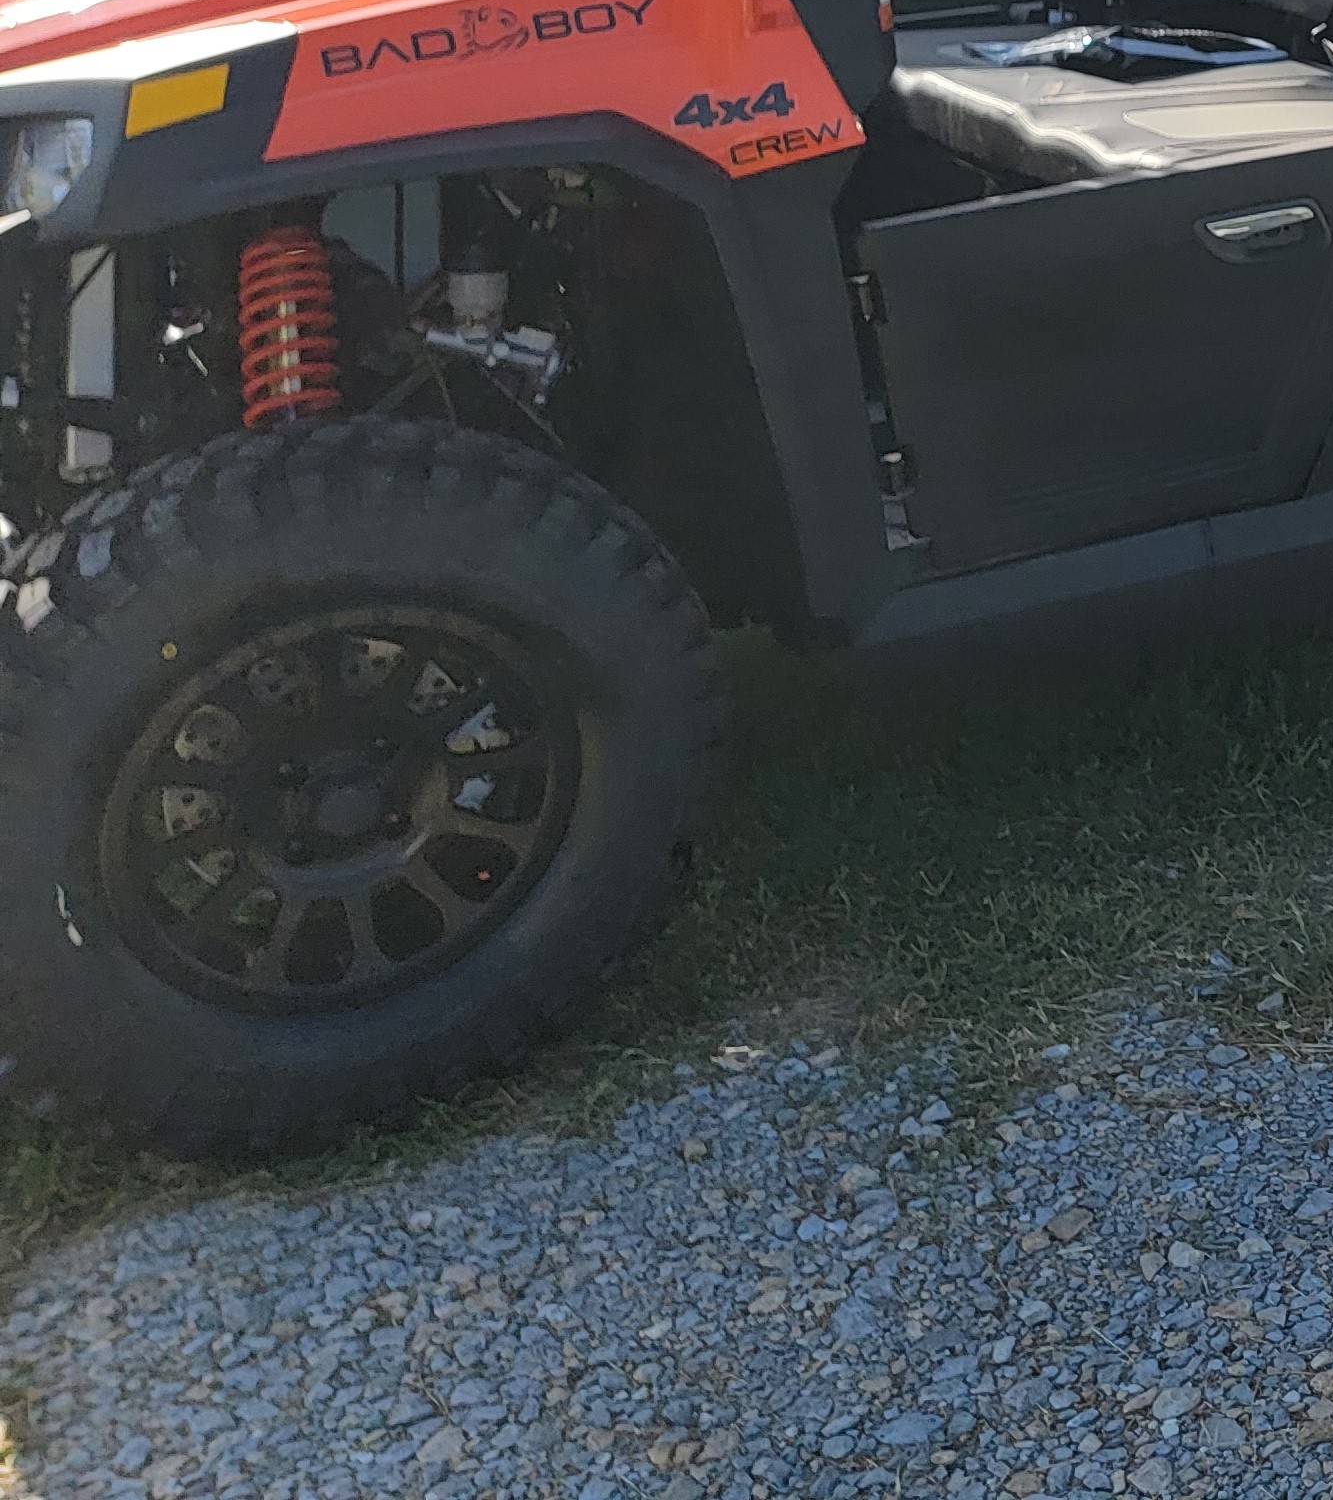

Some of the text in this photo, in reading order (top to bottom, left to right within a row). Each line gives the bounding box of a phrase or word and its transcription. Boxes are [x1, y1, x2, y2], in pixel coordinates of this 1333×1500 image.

[321, 28, 456, 77] BAD
[674, 82, 795, 128] 4x4
[730, 118, 842, 165] CREW
